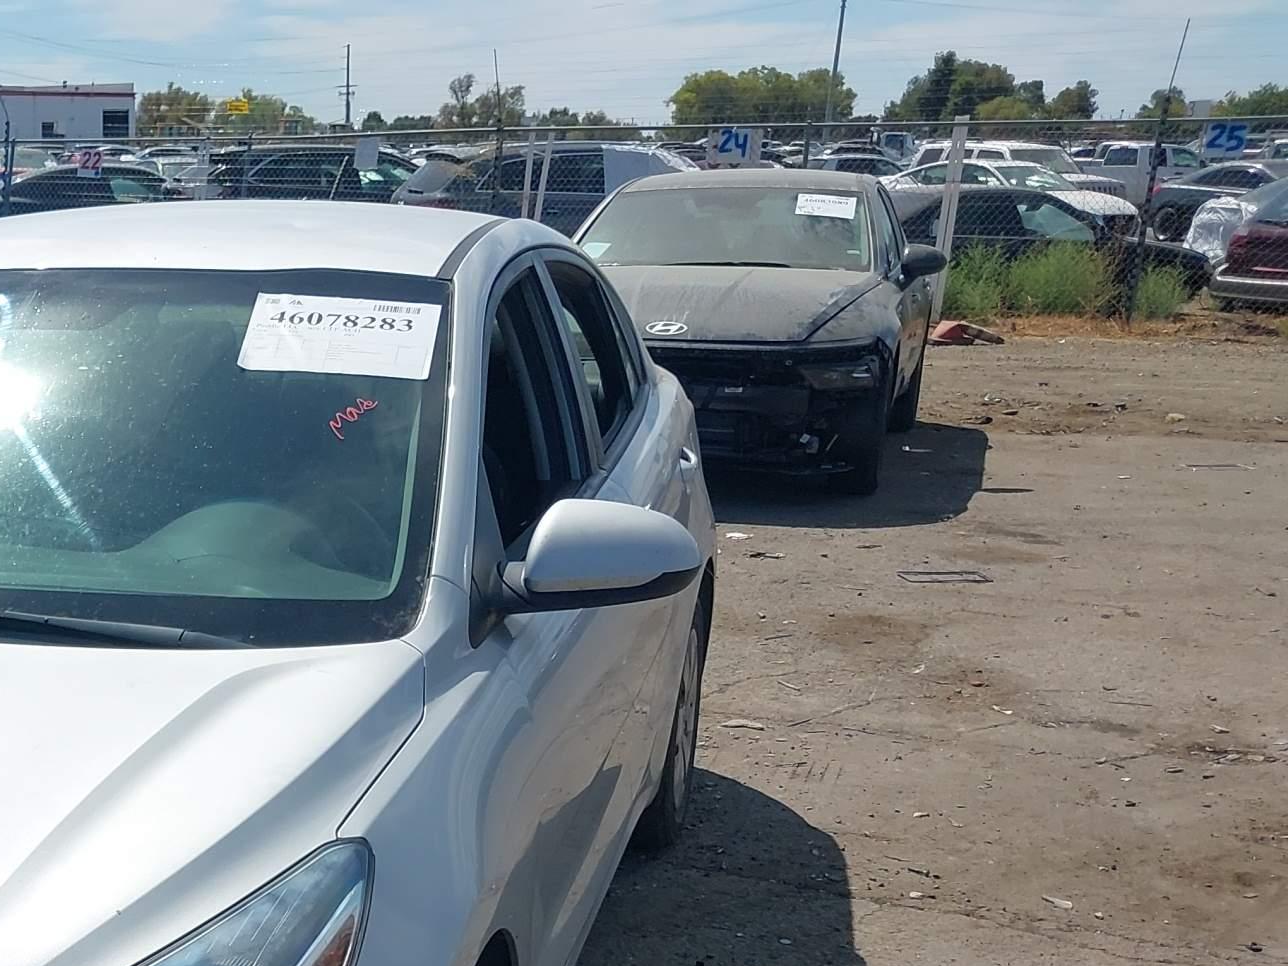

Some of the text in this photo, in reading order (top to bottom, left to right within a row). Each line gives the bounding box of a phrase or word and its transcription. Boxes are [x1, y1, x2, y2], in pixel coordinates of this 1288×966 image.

[718, 128, 749, 158] 24
[1205, 124, 1248, 152] 25
[81, 151, 101, 170] 22
[270, 310, 415, 333] 46078283
